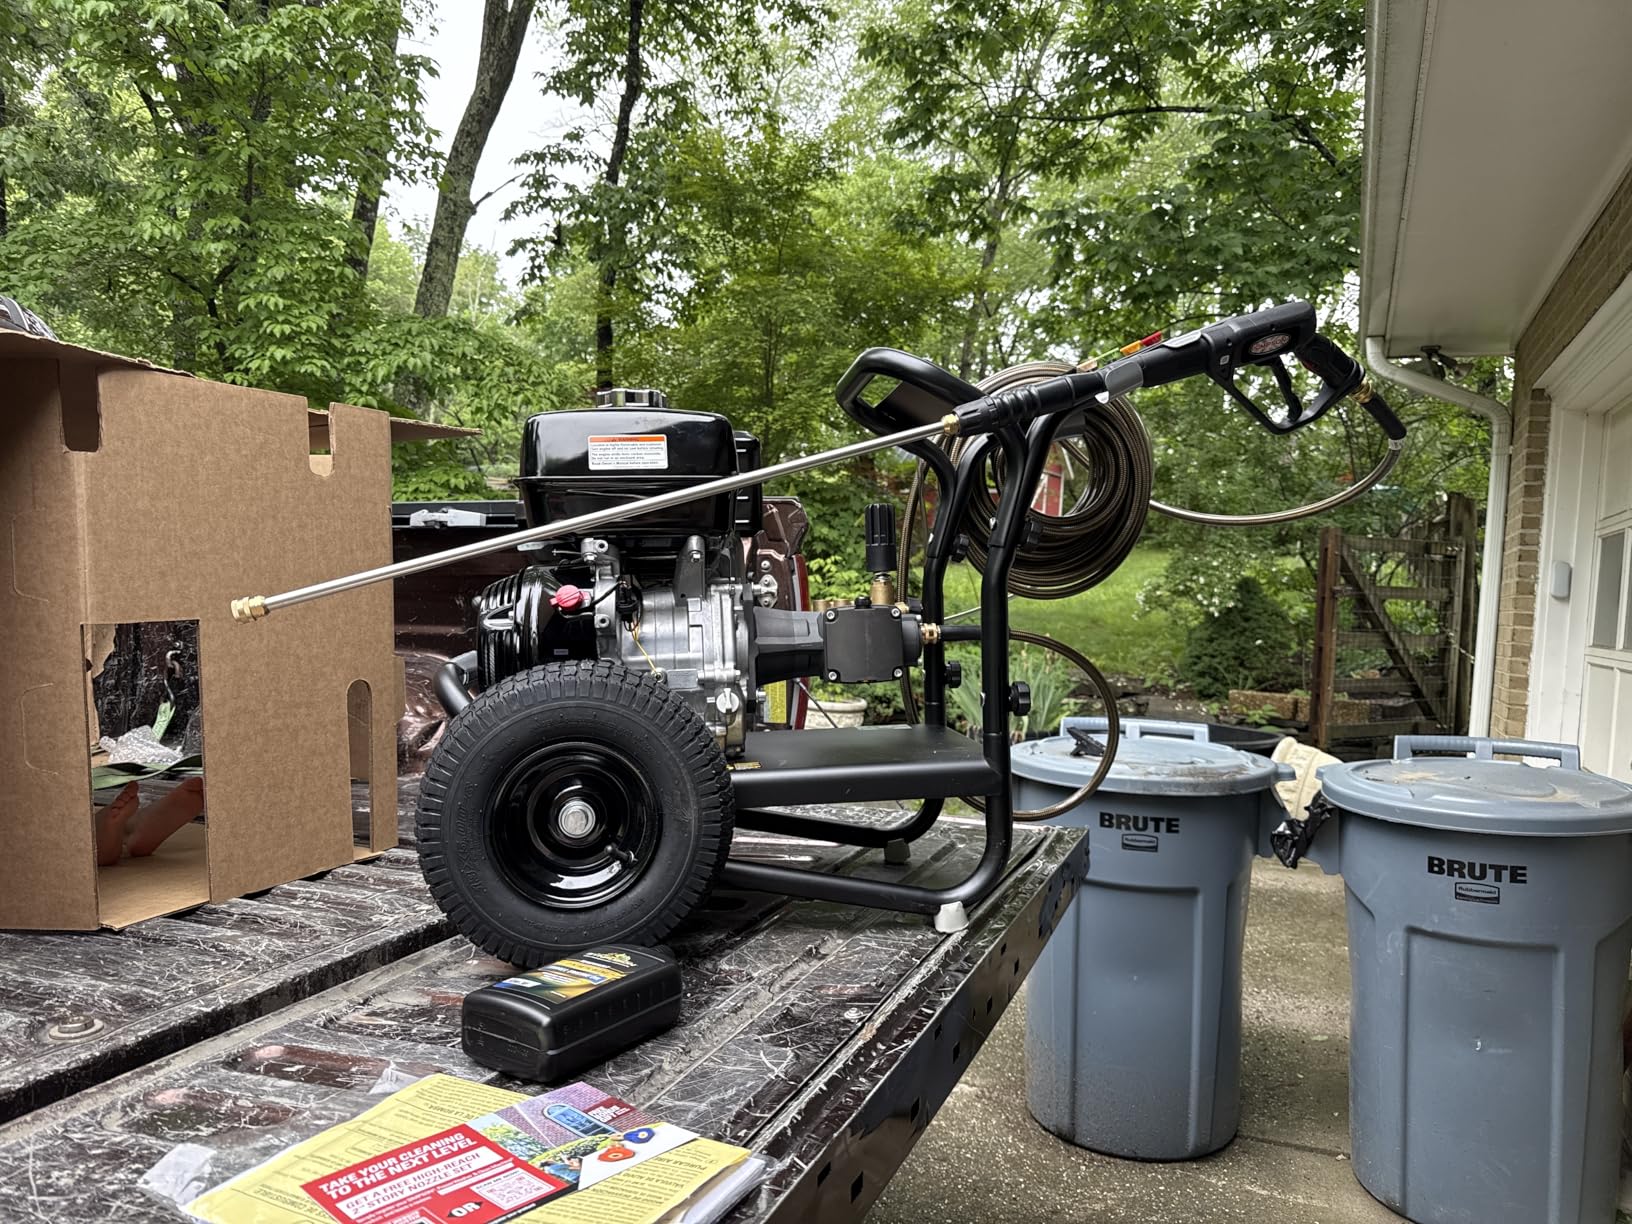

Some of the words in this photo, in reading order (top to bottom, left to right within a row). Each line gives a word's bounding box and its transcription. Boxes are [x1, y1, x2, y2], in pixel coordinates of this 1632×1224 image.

[1099, 811, 1180, 834] BRUTE
[1427, 855, 1528, 884] BRUTE
[1458, 886, 1497, 895] Rubbermaid
[318, 1172, 358, 1193] TAKE
[358, 1157, 398, 1177] YOUR
[399, 1132, 466, 1161] CLEANING
[327, 1184, 352, 1200] TO
[351, 1170, 388, 1189] THE
[388, 1152, 431, 1176] NEXT
[431, 1138, 478, 1159] LEVEL
[346, 1194, 370, 1209] GET
[372, 1191, 381, 1199] A
[383, 1177, 412, 1194] FREE
[412, 1152, 481, 1183] HIGH-REACH
[366, 1189, 405, 1208] STORY
[408, 1170, 452, 1191] NOZZLE
[452, 1162, 474, 1174] SET
[450, 1201, 481, 1218] OR
